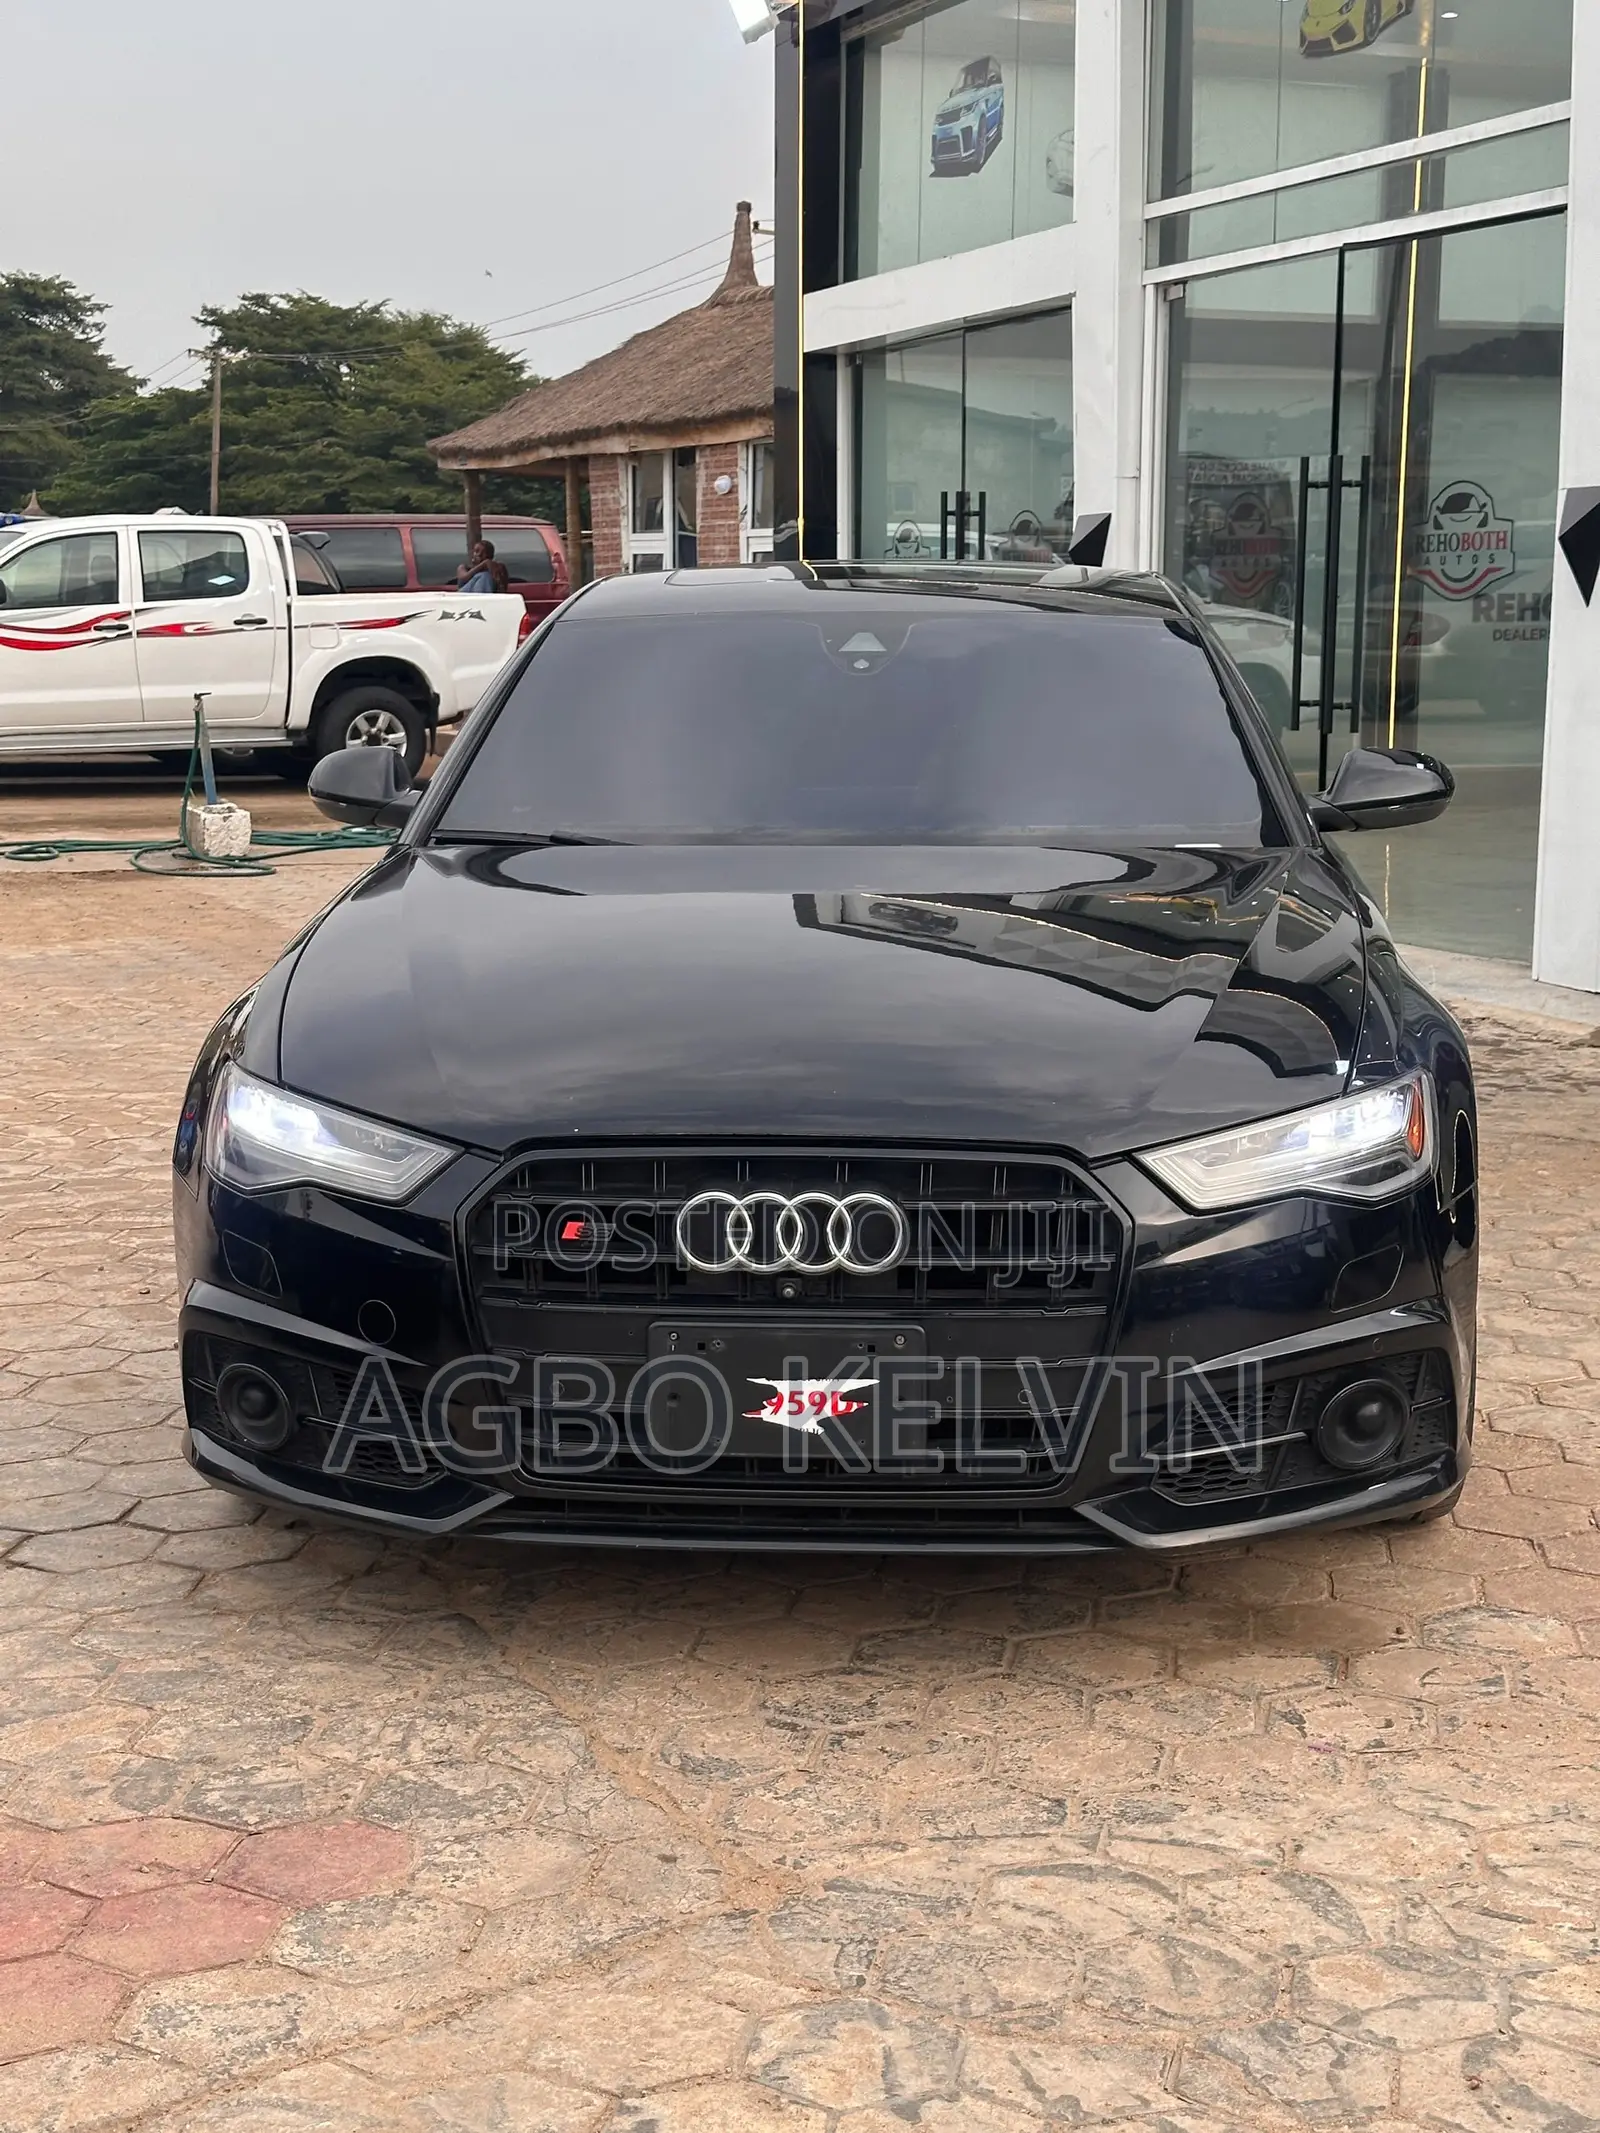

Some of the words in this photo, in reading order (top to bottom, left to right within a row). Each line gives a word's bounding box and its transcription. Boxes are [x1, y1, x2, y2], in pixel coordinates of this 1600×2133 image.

[1415, 531, 1508, 553] REHOBOTH
[1424, 553, 1496, 566] AUTOS
[1493, 628, 1549, 641] DEALER
